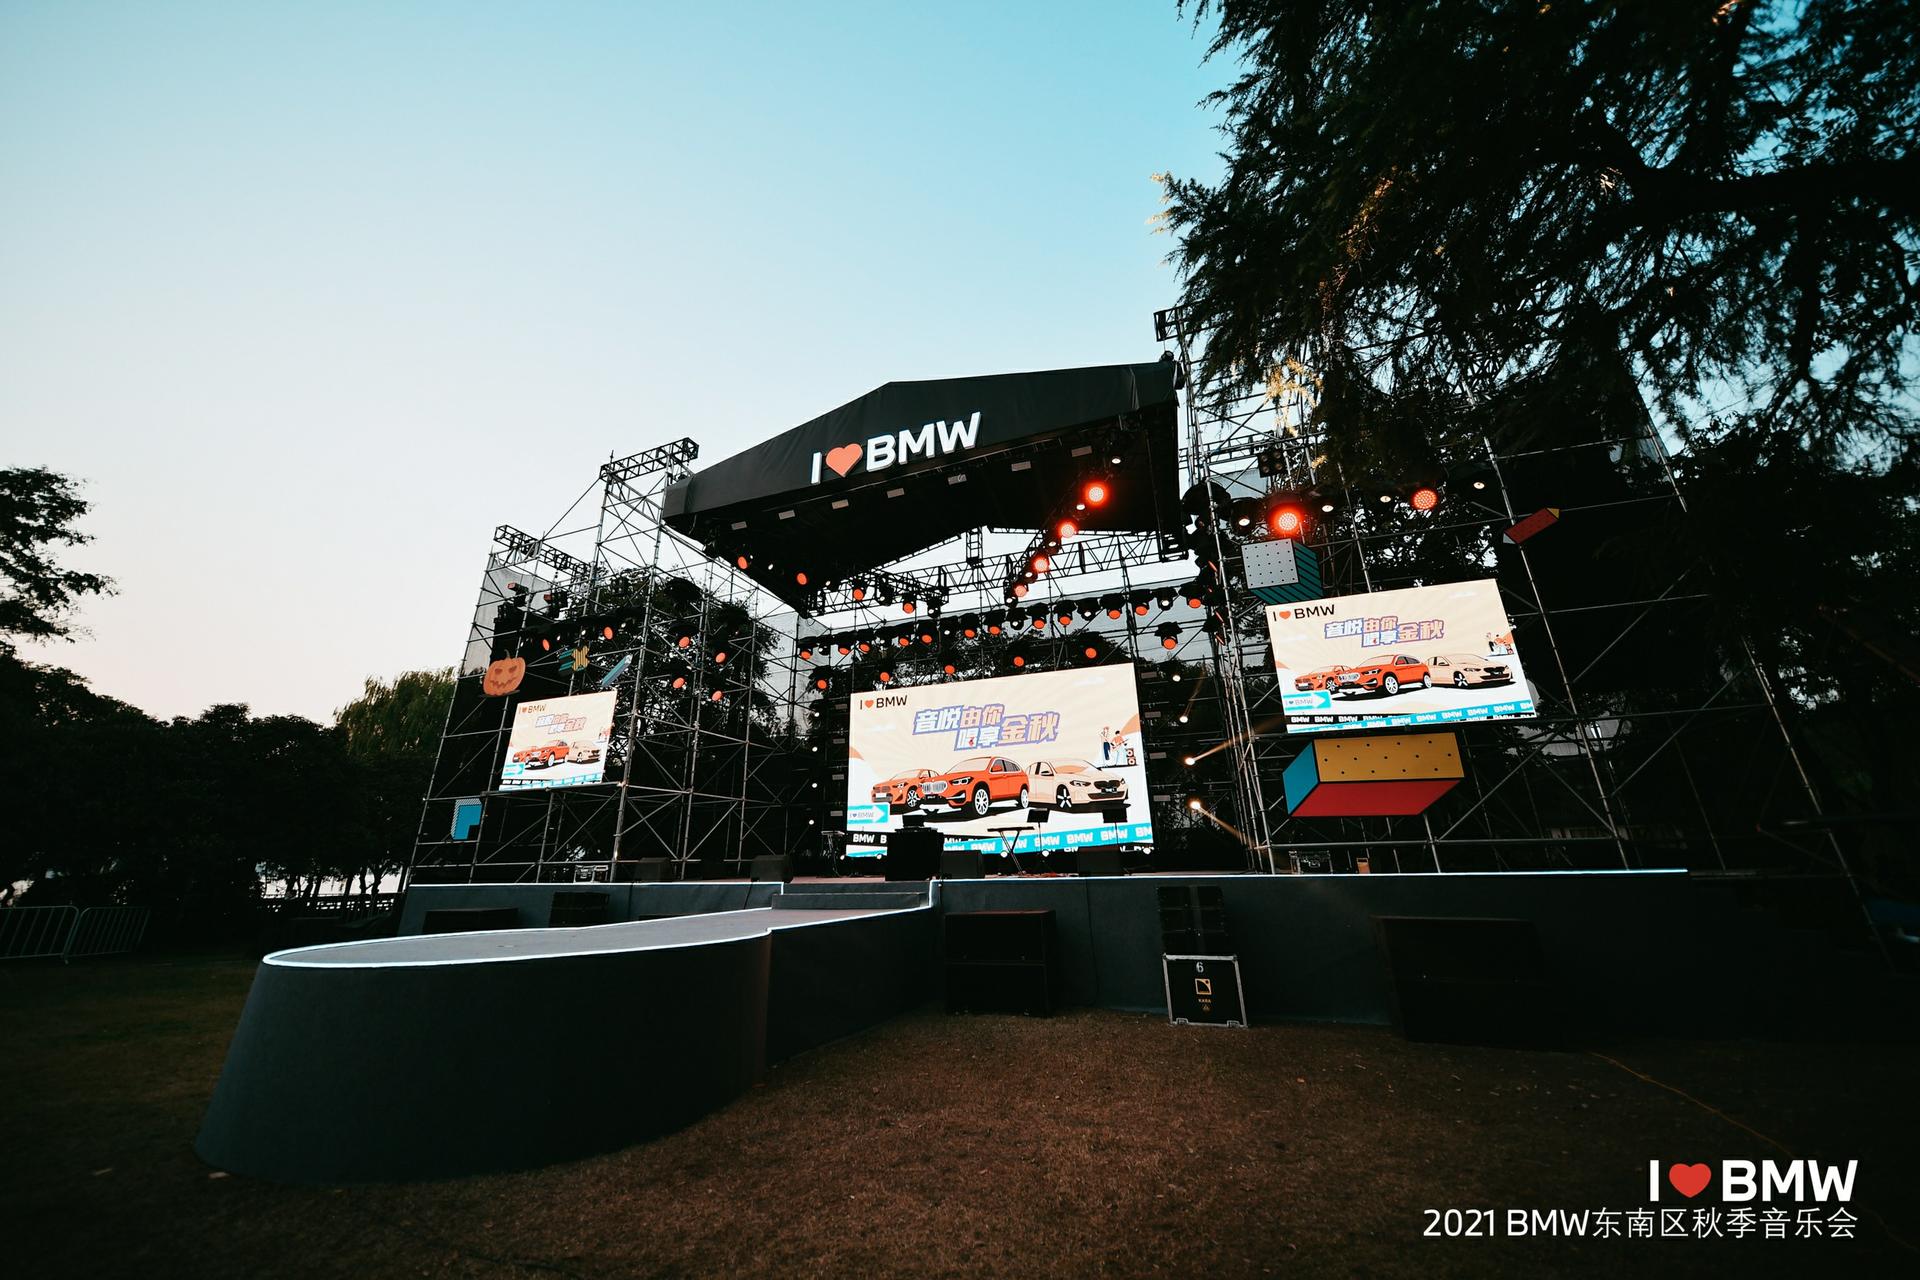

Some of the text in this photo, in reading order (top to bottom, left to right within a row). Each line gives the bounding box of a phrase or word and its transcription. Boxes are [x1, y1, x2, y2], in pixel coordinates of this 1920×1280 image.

[811, 411, 981, 485] I BMW
[1273, 604, 1335, 621] I BMW
[528, 704, 547, 713] BMW
[860, 695, 907, 710] I BMW
[913, 704, 1004, 735] 音悦由你
[1441, 711, 1462, 719] BMW
[1467, 708, 1488, 716] BMW
[1494, 705, 1514, 713] BMW
[853, 833, 875, 843] BMW
[1035, 835, 1060, 846] BMW
[1066, 832, 1093, 844] BMW
[1101, 829, 1128, 841] BMW
[1196, 962, 1204, 973] 6
